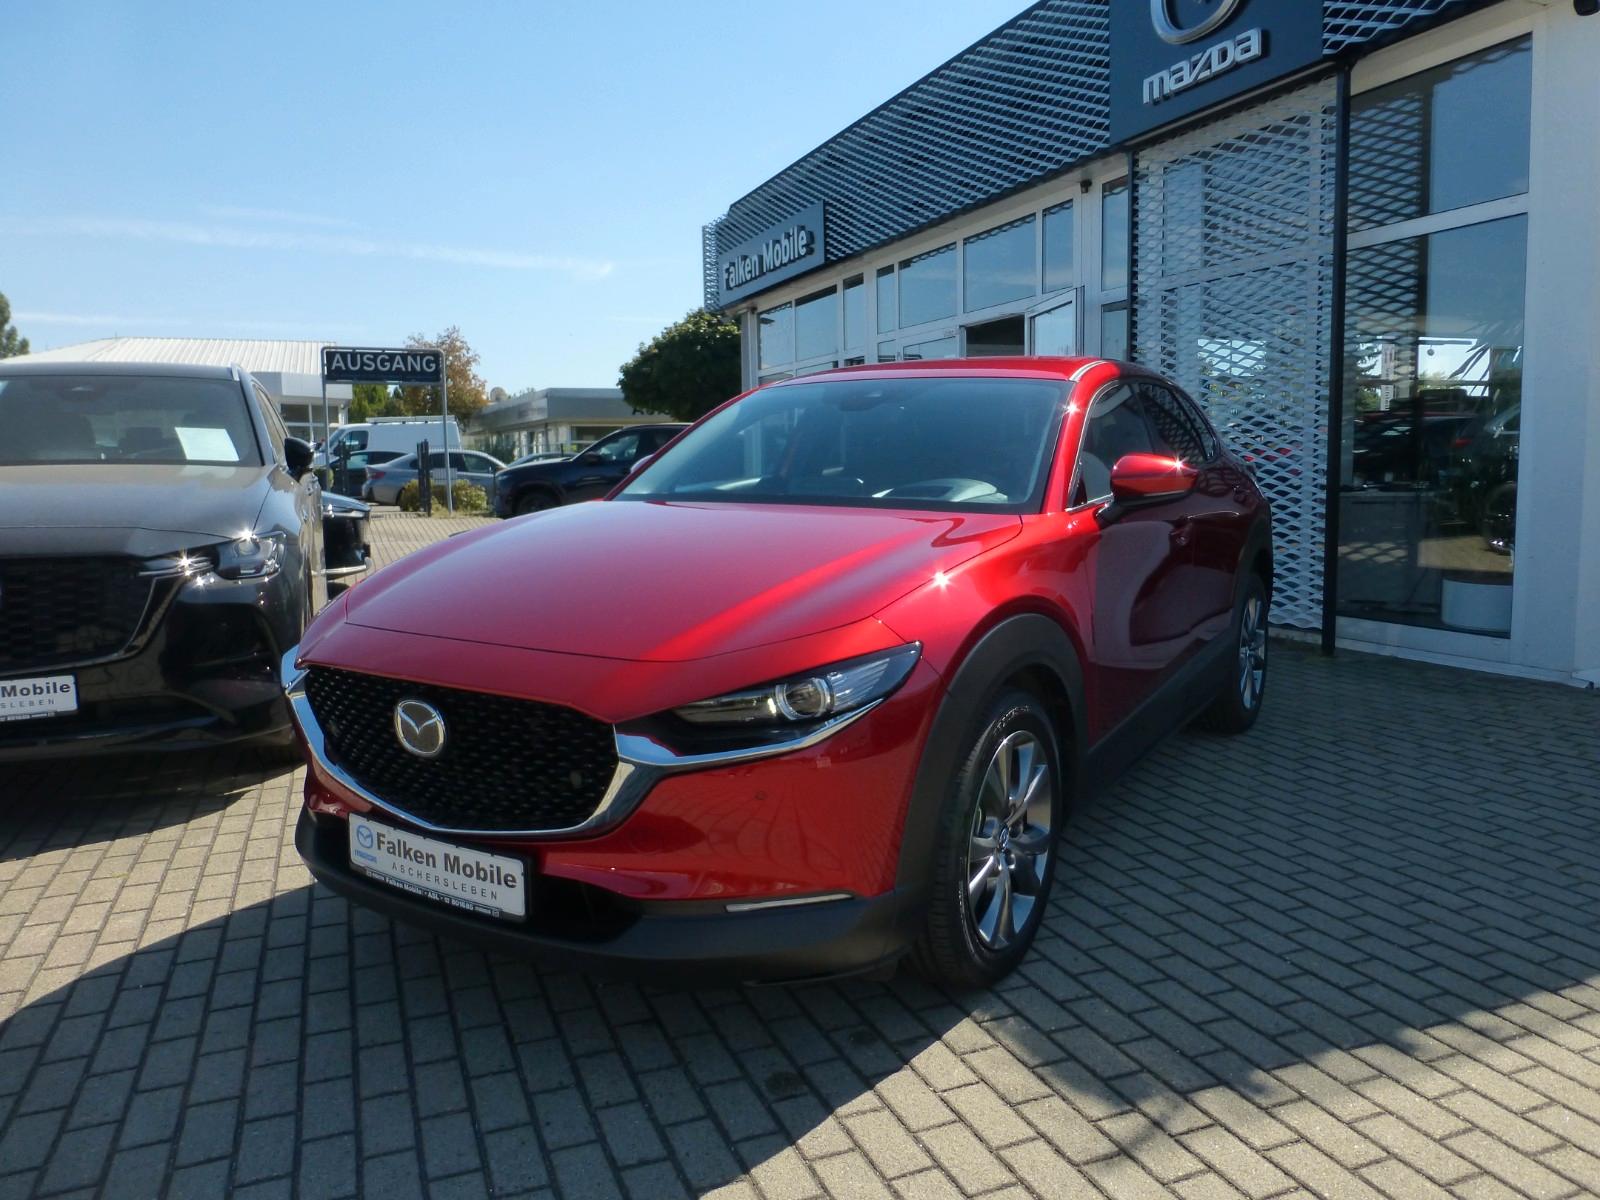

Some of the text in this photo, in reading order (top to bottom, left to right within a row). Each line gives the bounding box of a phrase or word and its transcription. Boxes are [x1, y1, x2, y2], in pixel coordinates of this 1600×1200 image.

[723, 225, 807, 289] Falken Mobile
[331, 353, 437, 372] AUSGANG
[1, 682, 71, 698] Mobile
[376, 831, 518, 889] Falken Mobile
[391, 862, 498, 901] ASCHERSLEBEN
